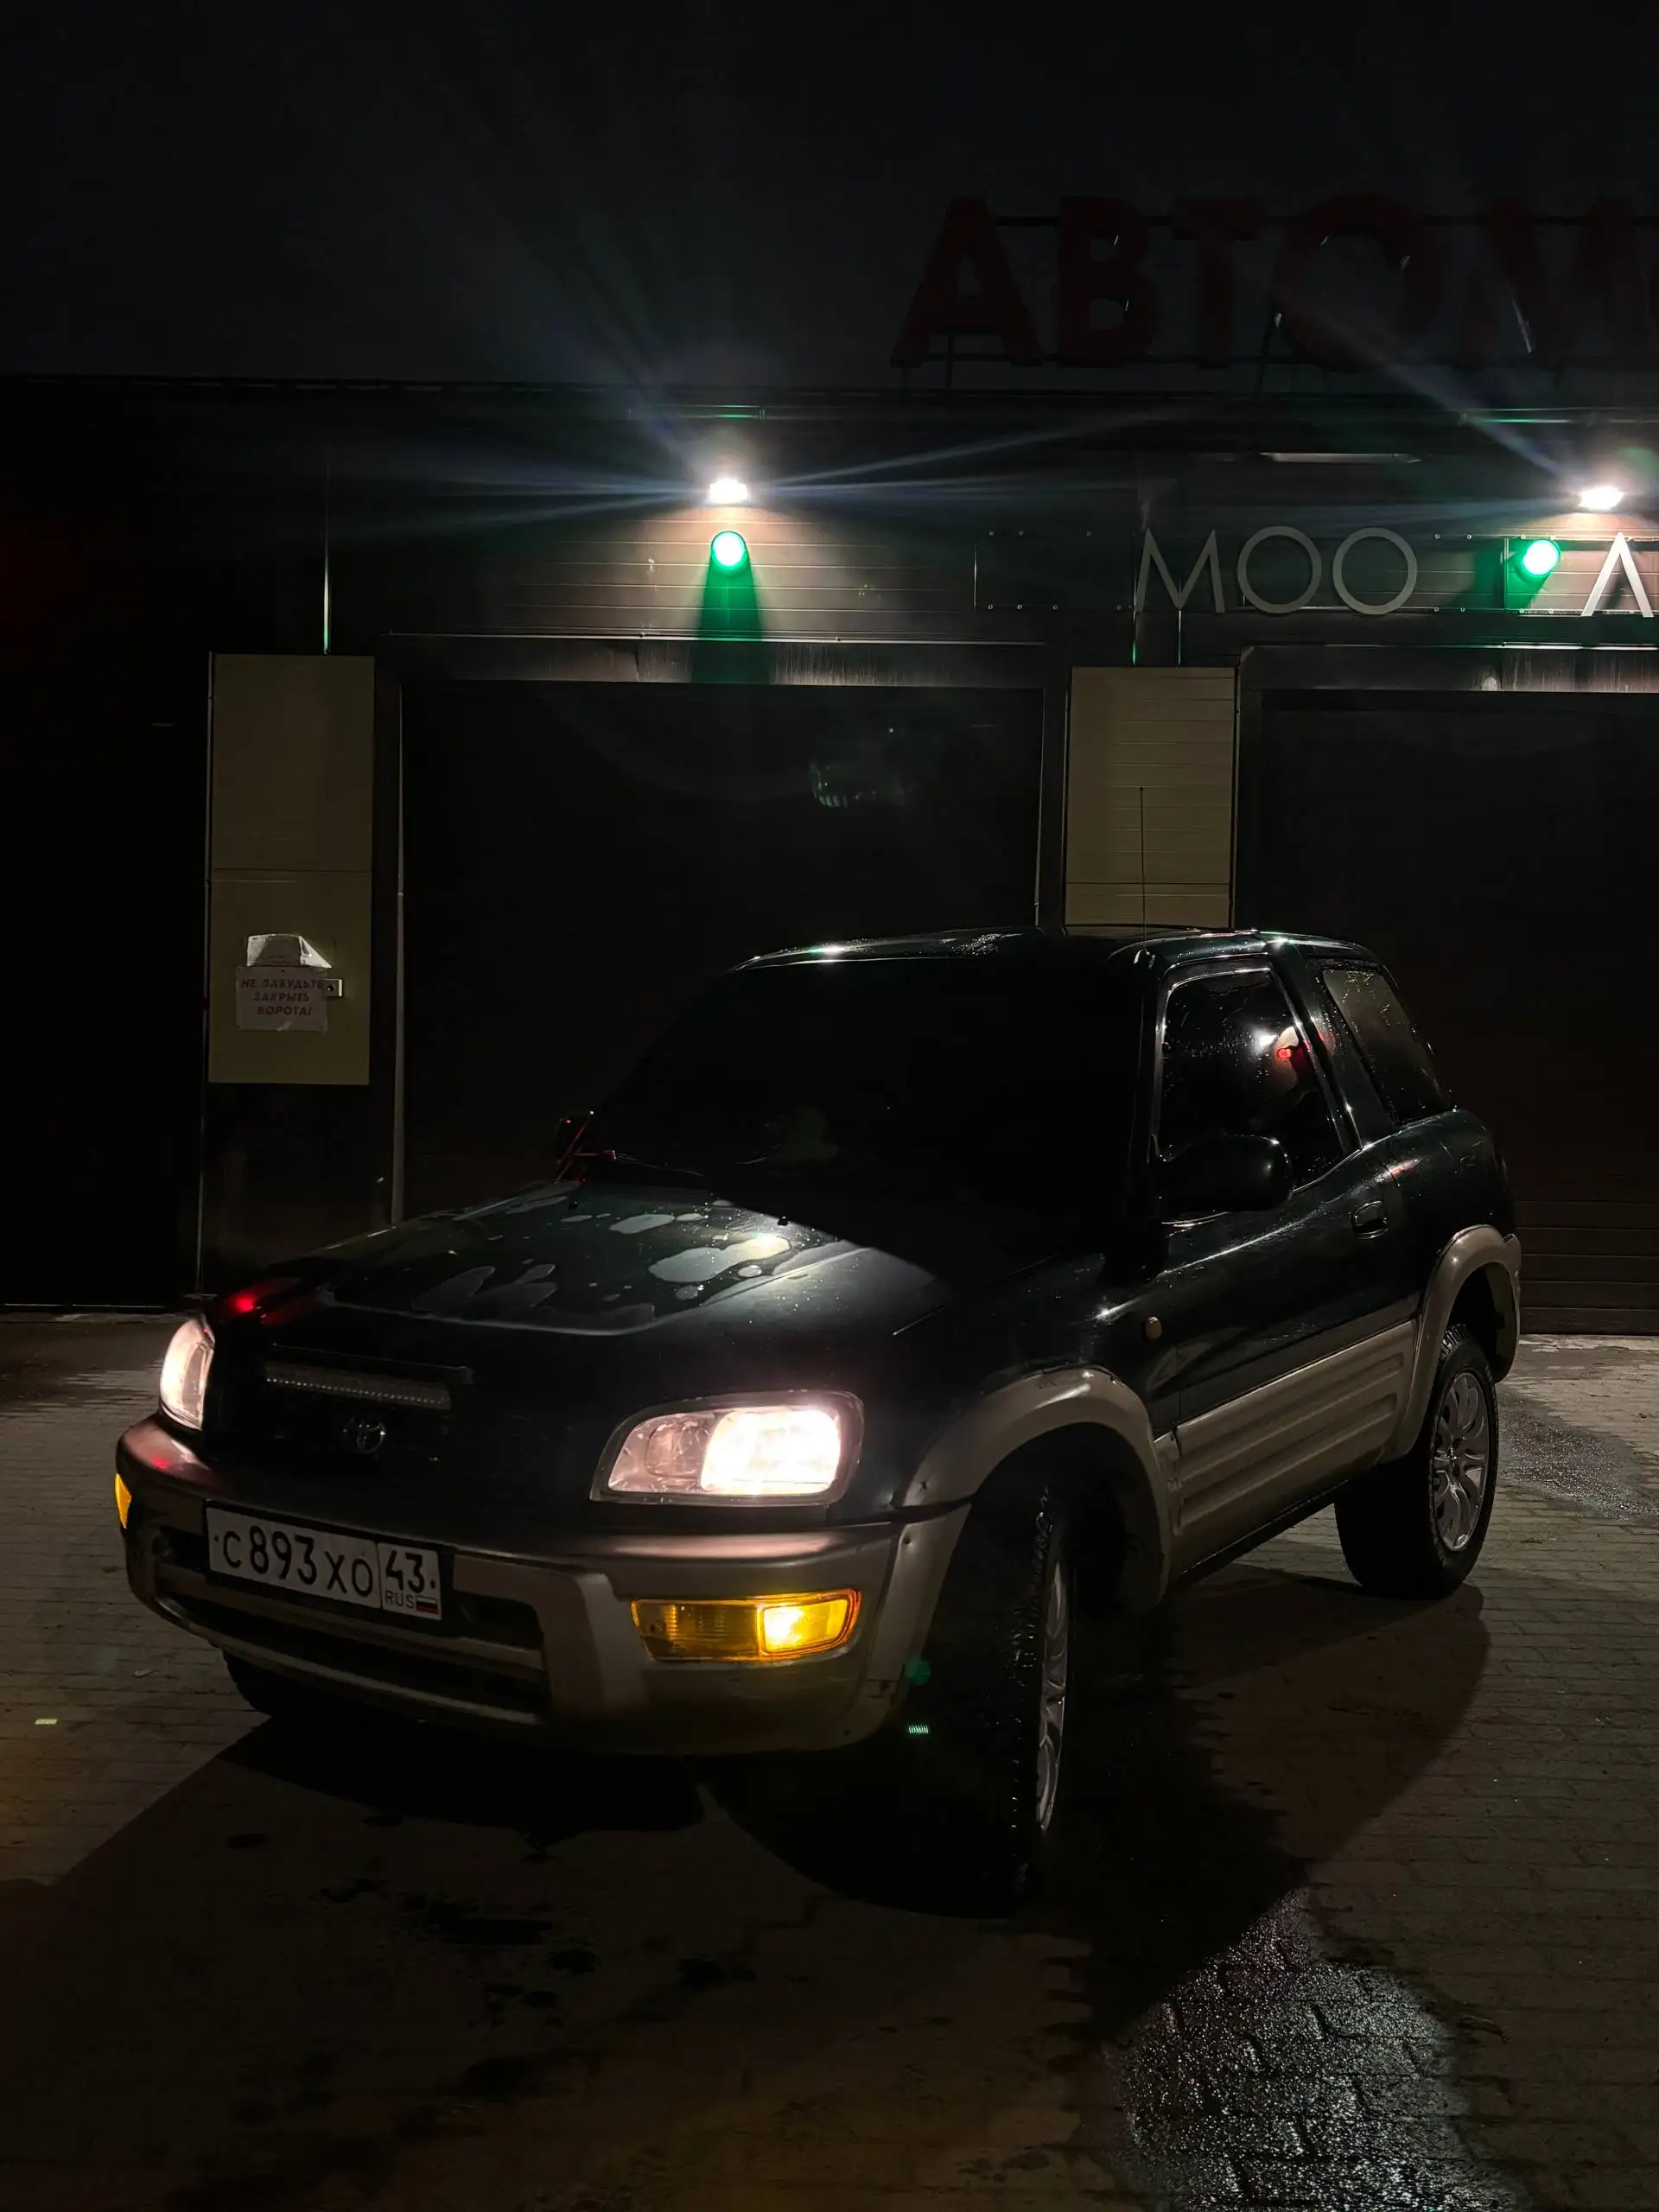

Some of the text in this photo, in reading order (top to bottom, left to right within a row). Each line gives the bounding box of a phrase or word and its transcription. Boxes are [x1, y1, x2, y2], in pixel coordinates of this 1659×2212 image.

[890, 193, 1659, 372] АВТОМ
[240, 978, 325, 990] НЕ ЗАБУДЬТЕ
[252, 992, 310, 1003] ЗАКРЫТЬ
[257, 1005, 313, 1017] ВОРОТА!
[385, 1591, 415, 1609] RUS
